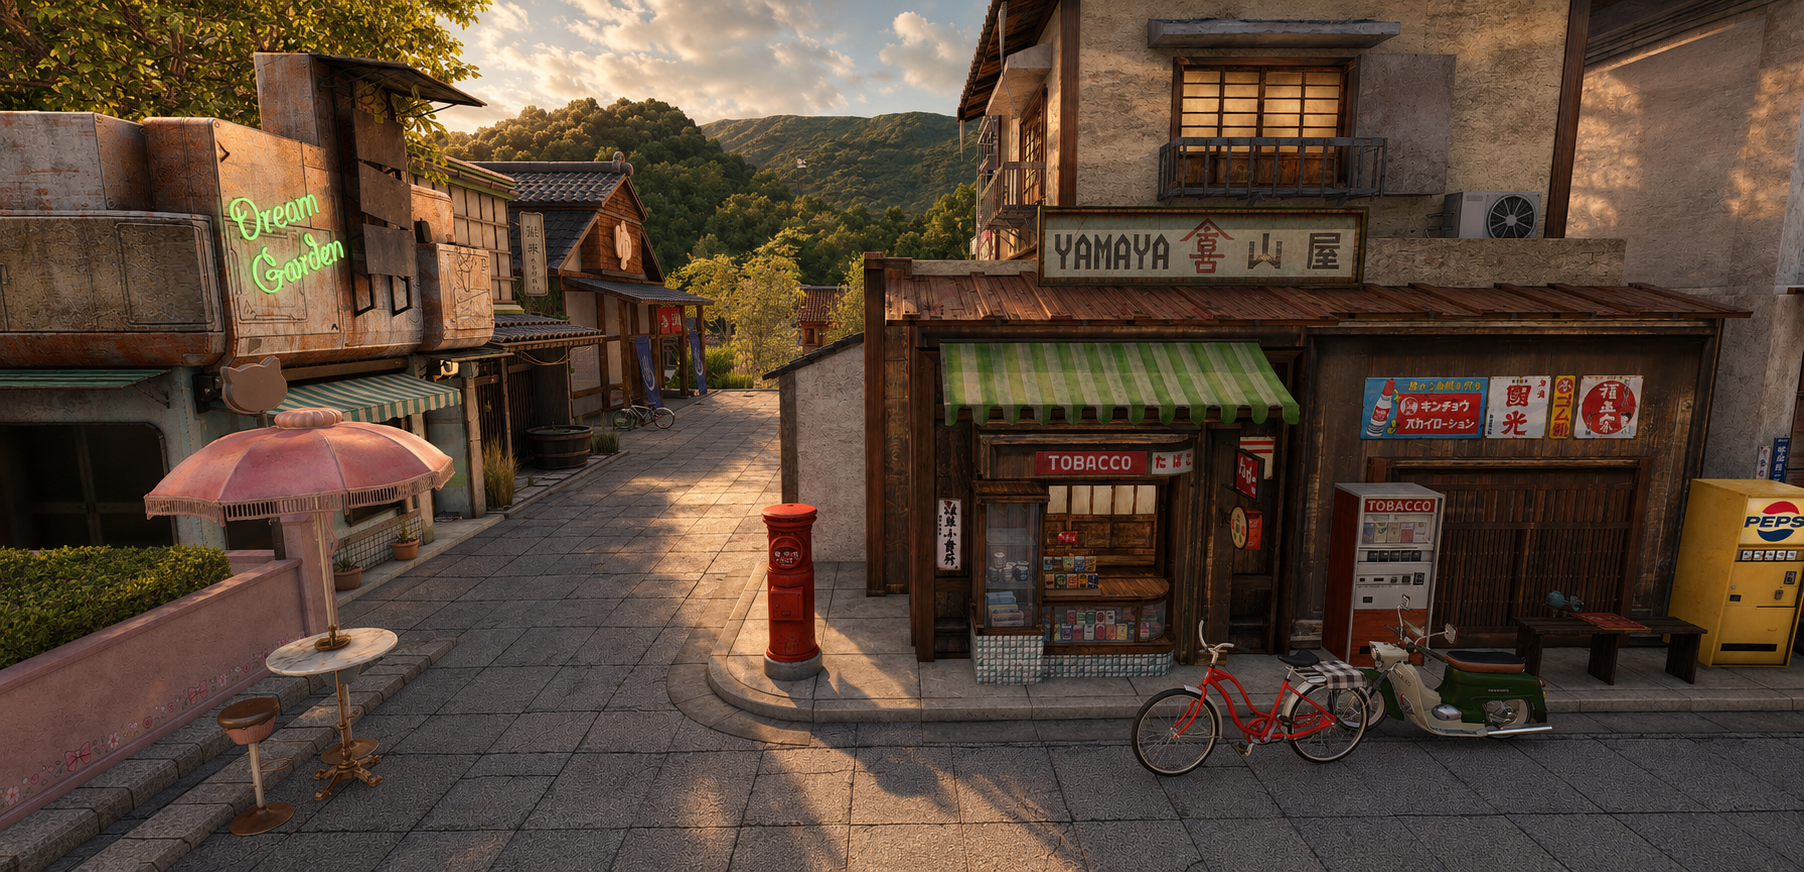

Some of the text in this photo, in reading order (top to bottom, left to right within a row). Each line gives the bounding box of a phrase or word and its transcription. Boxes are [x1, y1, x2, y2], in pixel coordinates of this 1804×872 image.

[228, 194, 320, 241] Dream
[1054, 233, 1170, 270] YAMAYA
[252, 233, 344, 294] Garden
[1421, 400, 1470, 413] キンチョウ
[1049, 455, 1132, 470] TOBACCO
[1155, 453, 1192, 469] たばこ
[1367, 500, 1431, 511] TOBACCO
